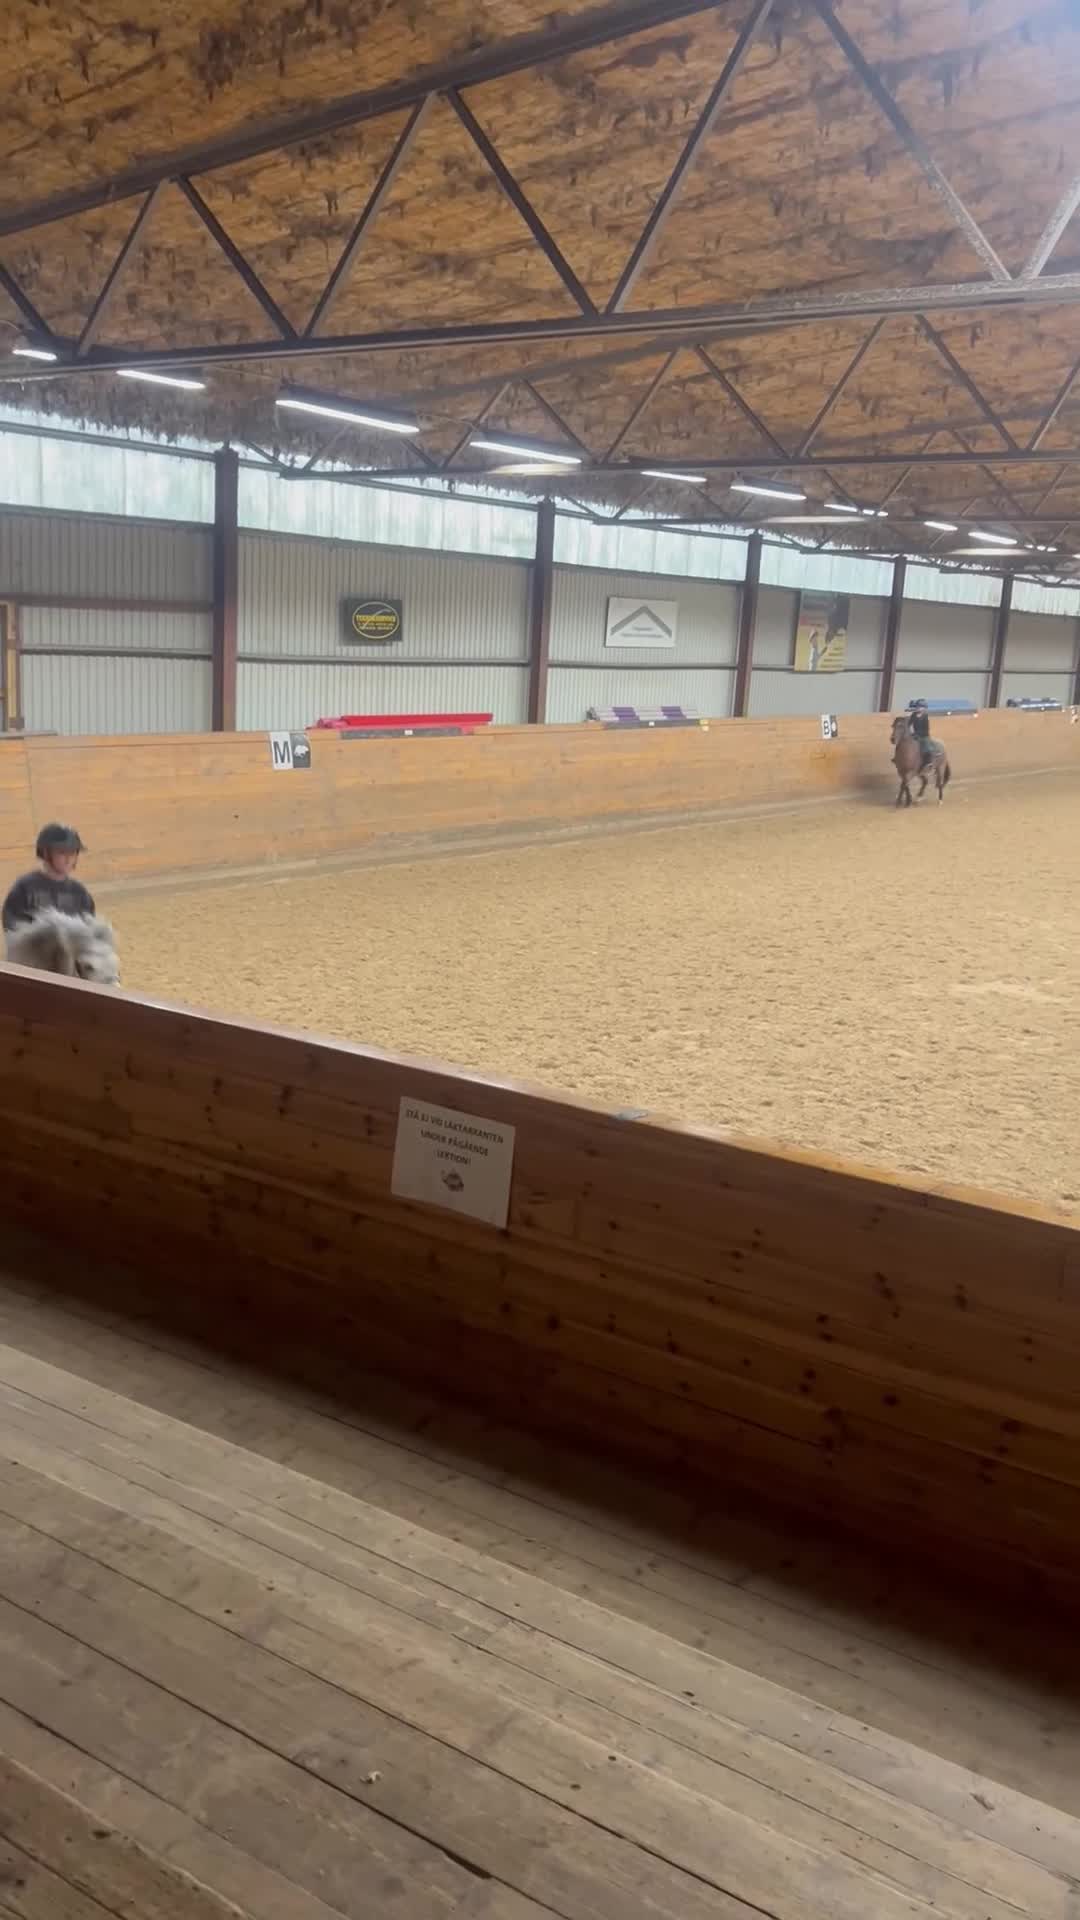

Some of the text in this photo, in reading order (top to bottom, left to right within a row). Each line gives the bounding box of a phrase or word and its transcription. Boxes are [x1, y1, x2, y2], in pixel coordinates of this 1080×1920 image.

[823, 720, 830, 735] B
[273, 741, 290, 763] M
[420, 1129, 446, 1143] UNDER
